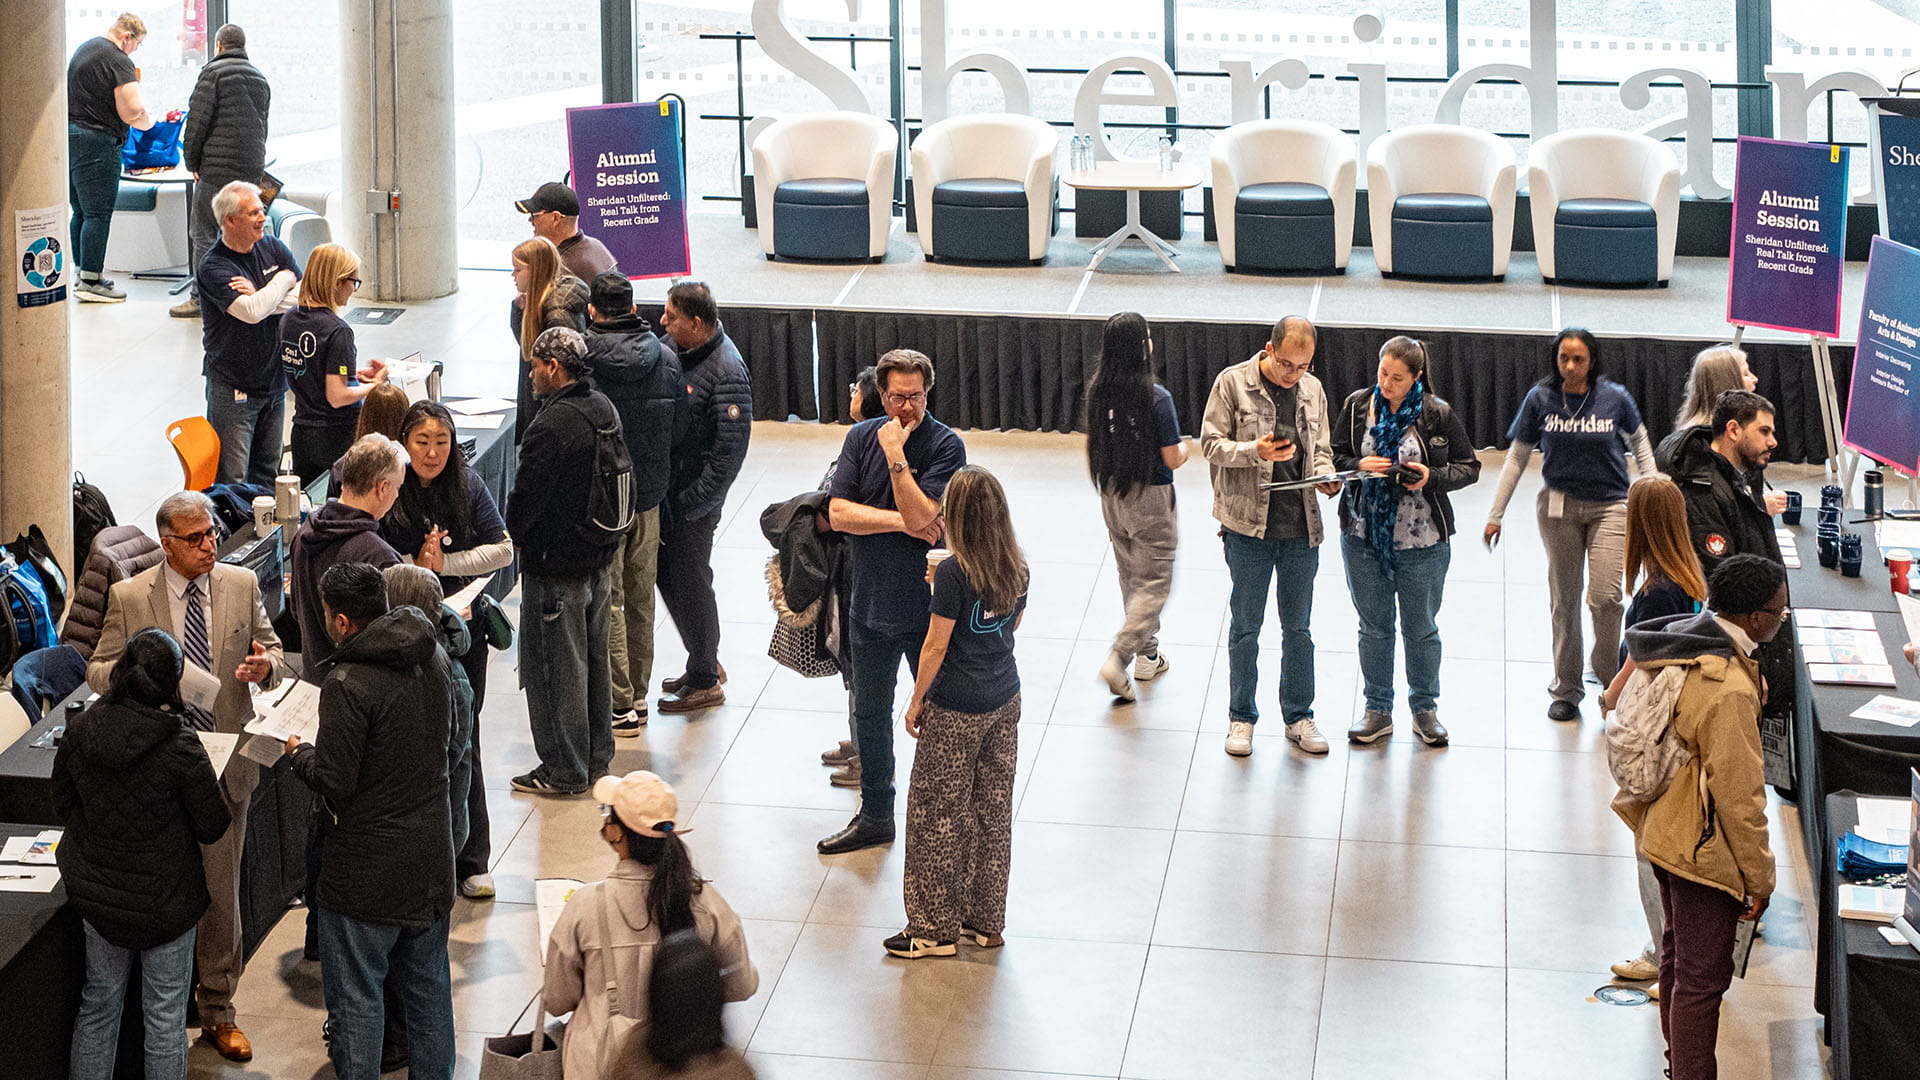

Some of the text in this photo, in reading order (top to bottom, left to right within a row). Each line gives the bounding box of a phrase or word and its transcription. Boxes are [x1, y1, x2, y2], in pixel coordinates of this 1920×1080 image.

[746, 0, 1890, 204] Sheridan
[596, 149, 657, 168] Alumni
[596, 170, 660, 187] Session
[587, 192, 671, 207] Sheridan Unfiltered:
[1759, 190, 1820, 211] Alumni
[600, 204, 660, 217] Real Talk from
[603, 215, 659, 228] Recent Grads
[1757, 210, 1820, 232] Session
[1745, 234, 1829, 253] Sheridan Unfiltered:
[1756, 247, 1816, 264] Real Talk from
[1757, 259, 1814, 275] Recent Grads
[1868, 309, 1890, 327] Faculty
[1889, 318, 1897, 328] of
[1877, 325, 1917, 349] Arts & Design
[1544, 413, 1614, 432] Sheridan
